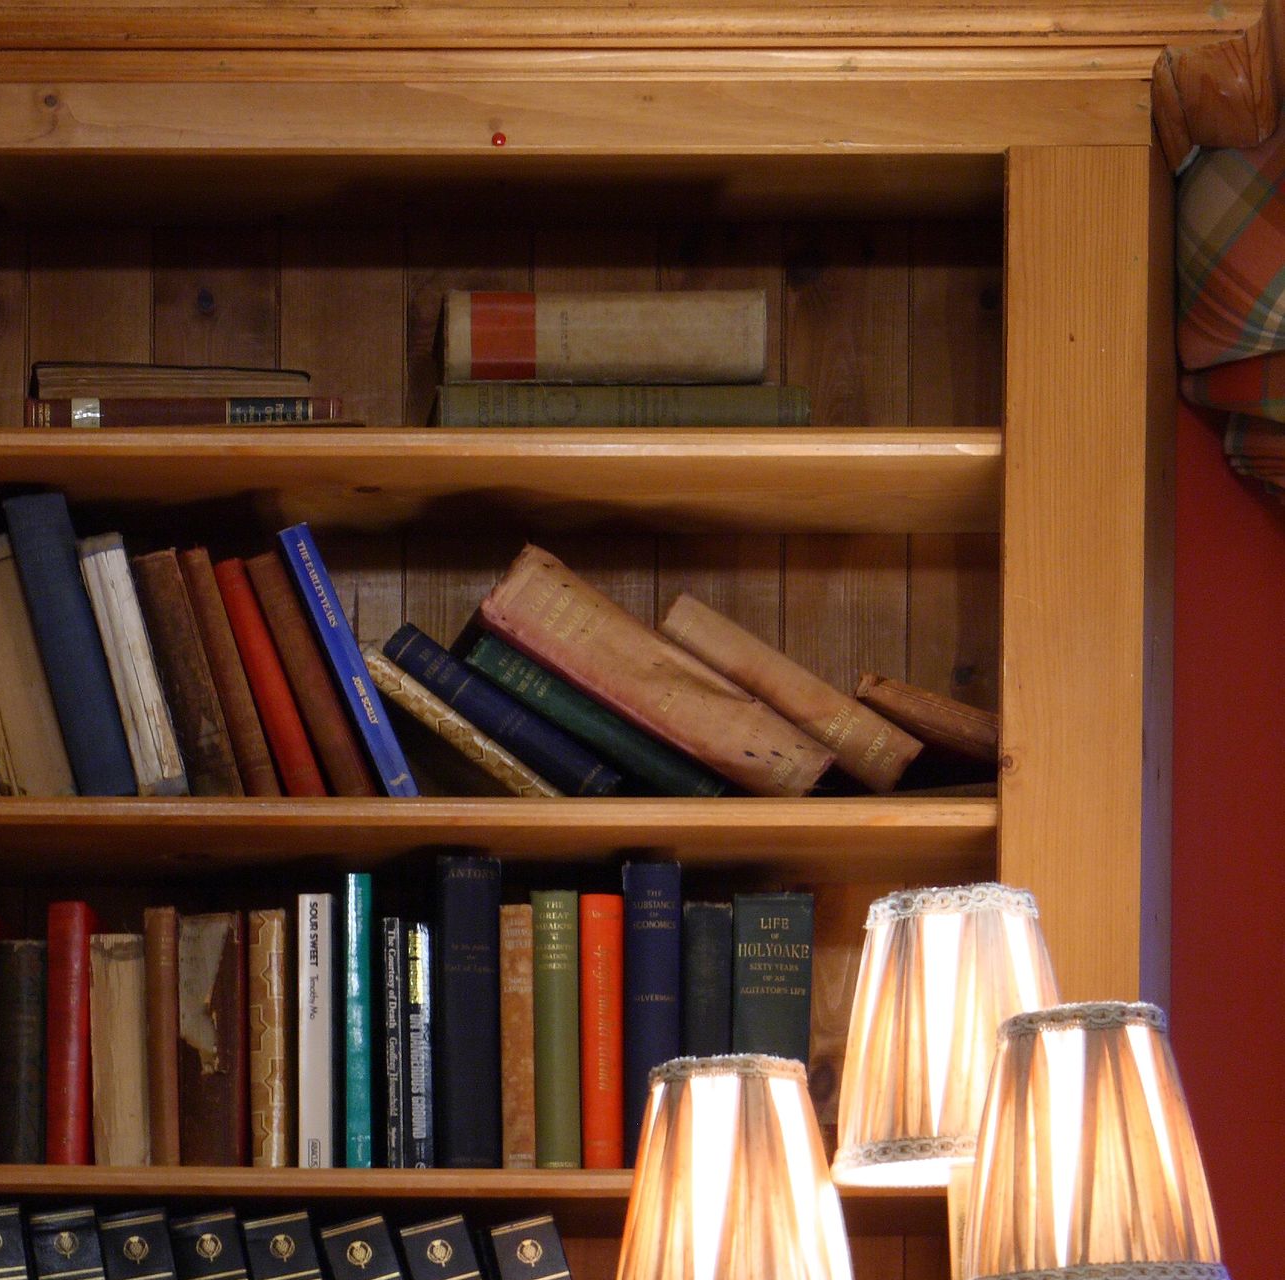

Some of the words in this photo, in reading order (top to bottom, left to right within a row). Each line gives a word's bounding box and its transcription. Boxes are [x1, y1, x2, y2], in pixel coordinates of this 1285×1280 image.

[295, 539, 311, 562] THE
[303, 560, 326, 598] EARLEY
[318, 596, 339, 628] YEARS
[351, 674, 367, 697] JOHN
[359, 695, 379, 725] SCALLY
[309, 902, 318, 930] SOUR
[760, 917, 790, 930] LIFE
[309, 933, 318, 966] SWEET
[388, 929, 396, 946] The
[738, 943, 810, 959] HOLYOAKE
[387, 948, 396, 988] Courtesy
[748, 963, 773, 972] SIXTY
[775, 964, 799, 972] YEARS
[309, 974, 319, 1004] Timothy
[388, 990, 397, 998] of
[791, 988, 806, 996] LIFE
[309, 1006, 317, 1020] Mo
[388, 1002, 397, 1028] Death
[387, 1036, 397, 1070] Geoffrey
[410, 1032, 425, 1094] DANGEROUS
[412, 1096, 427, 1139] GROUND
